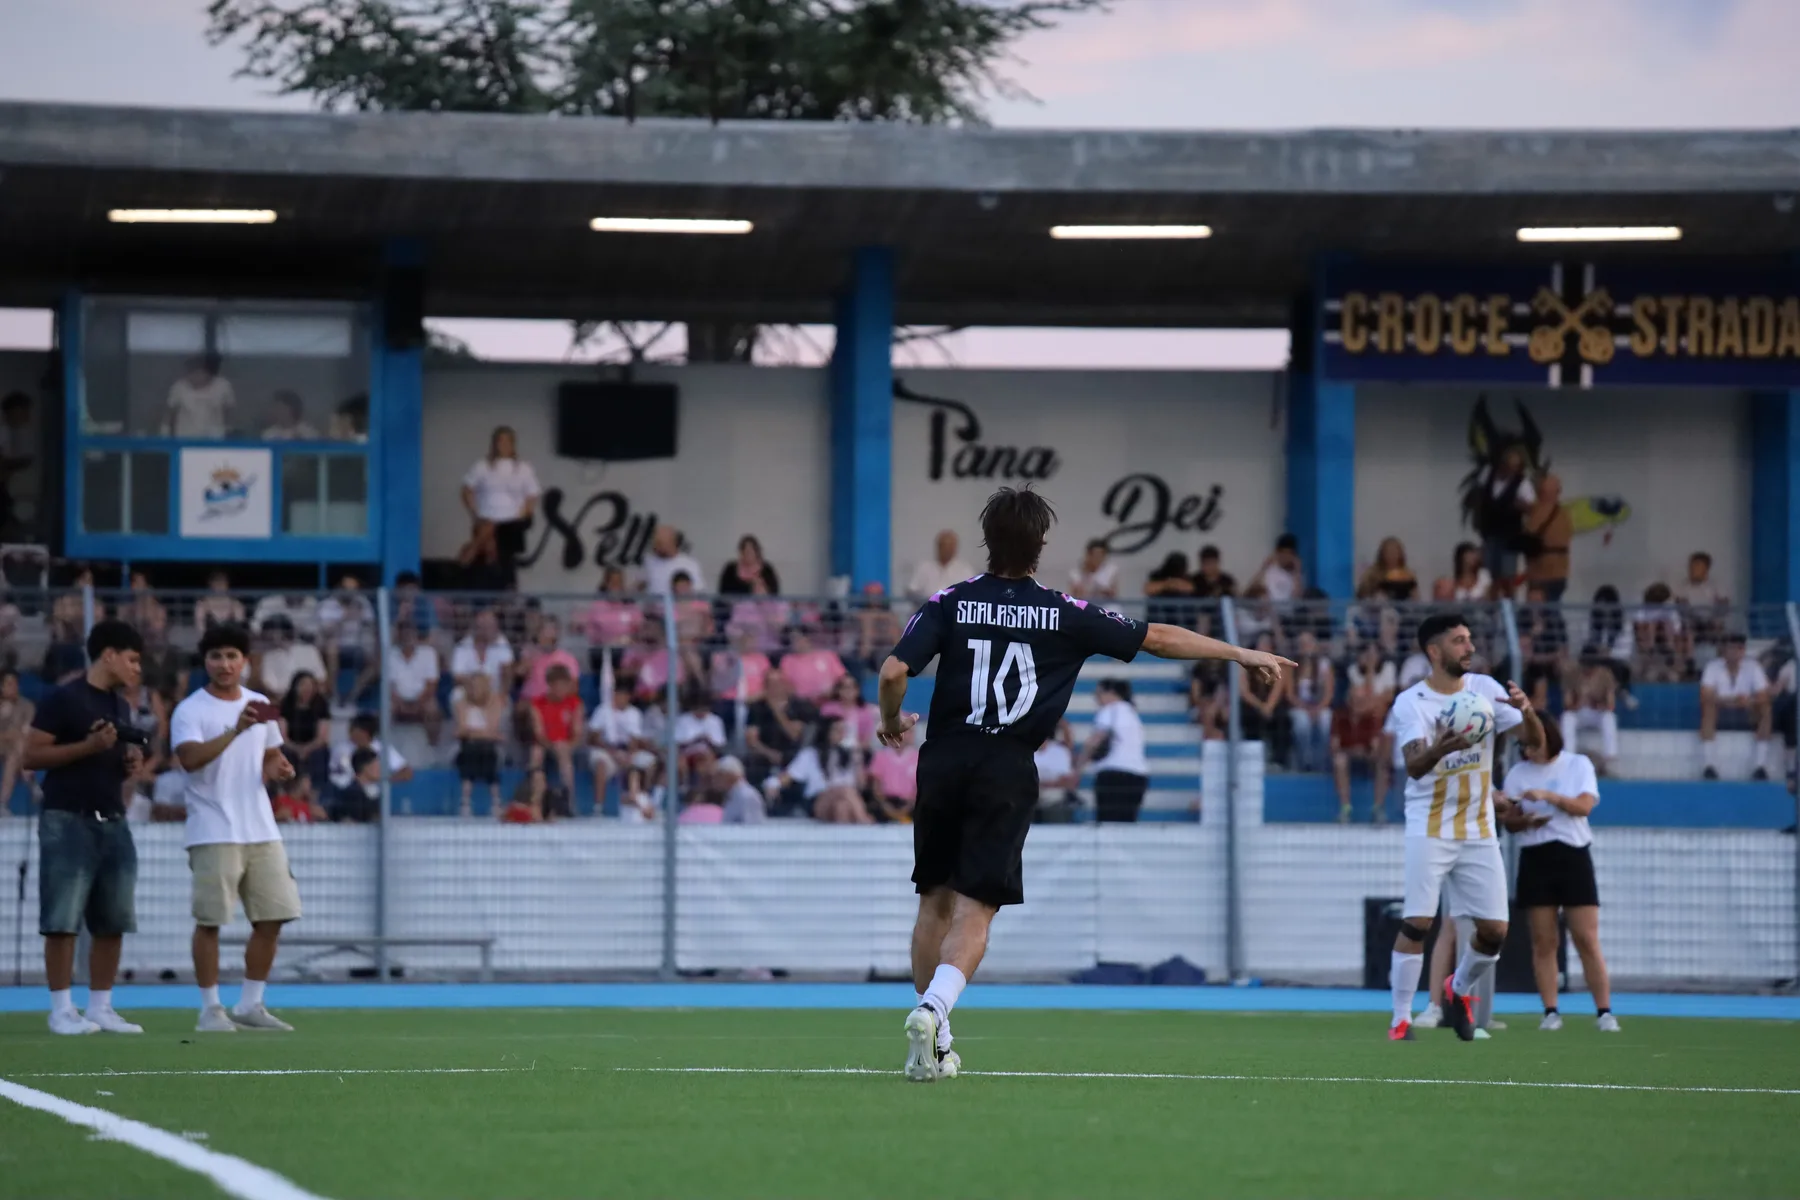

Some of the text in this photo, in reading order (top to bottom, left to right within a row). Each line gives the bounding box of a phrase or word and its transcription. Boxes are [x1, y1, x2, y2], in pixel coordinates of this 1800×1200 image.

[1341, 293, 1800, 357] CROCE STRADA
[1101, 472, 1224, 555] Dei
[957, 600, 1060, 631] SCALASANTA
[965, 638, 1039, 726] 10
